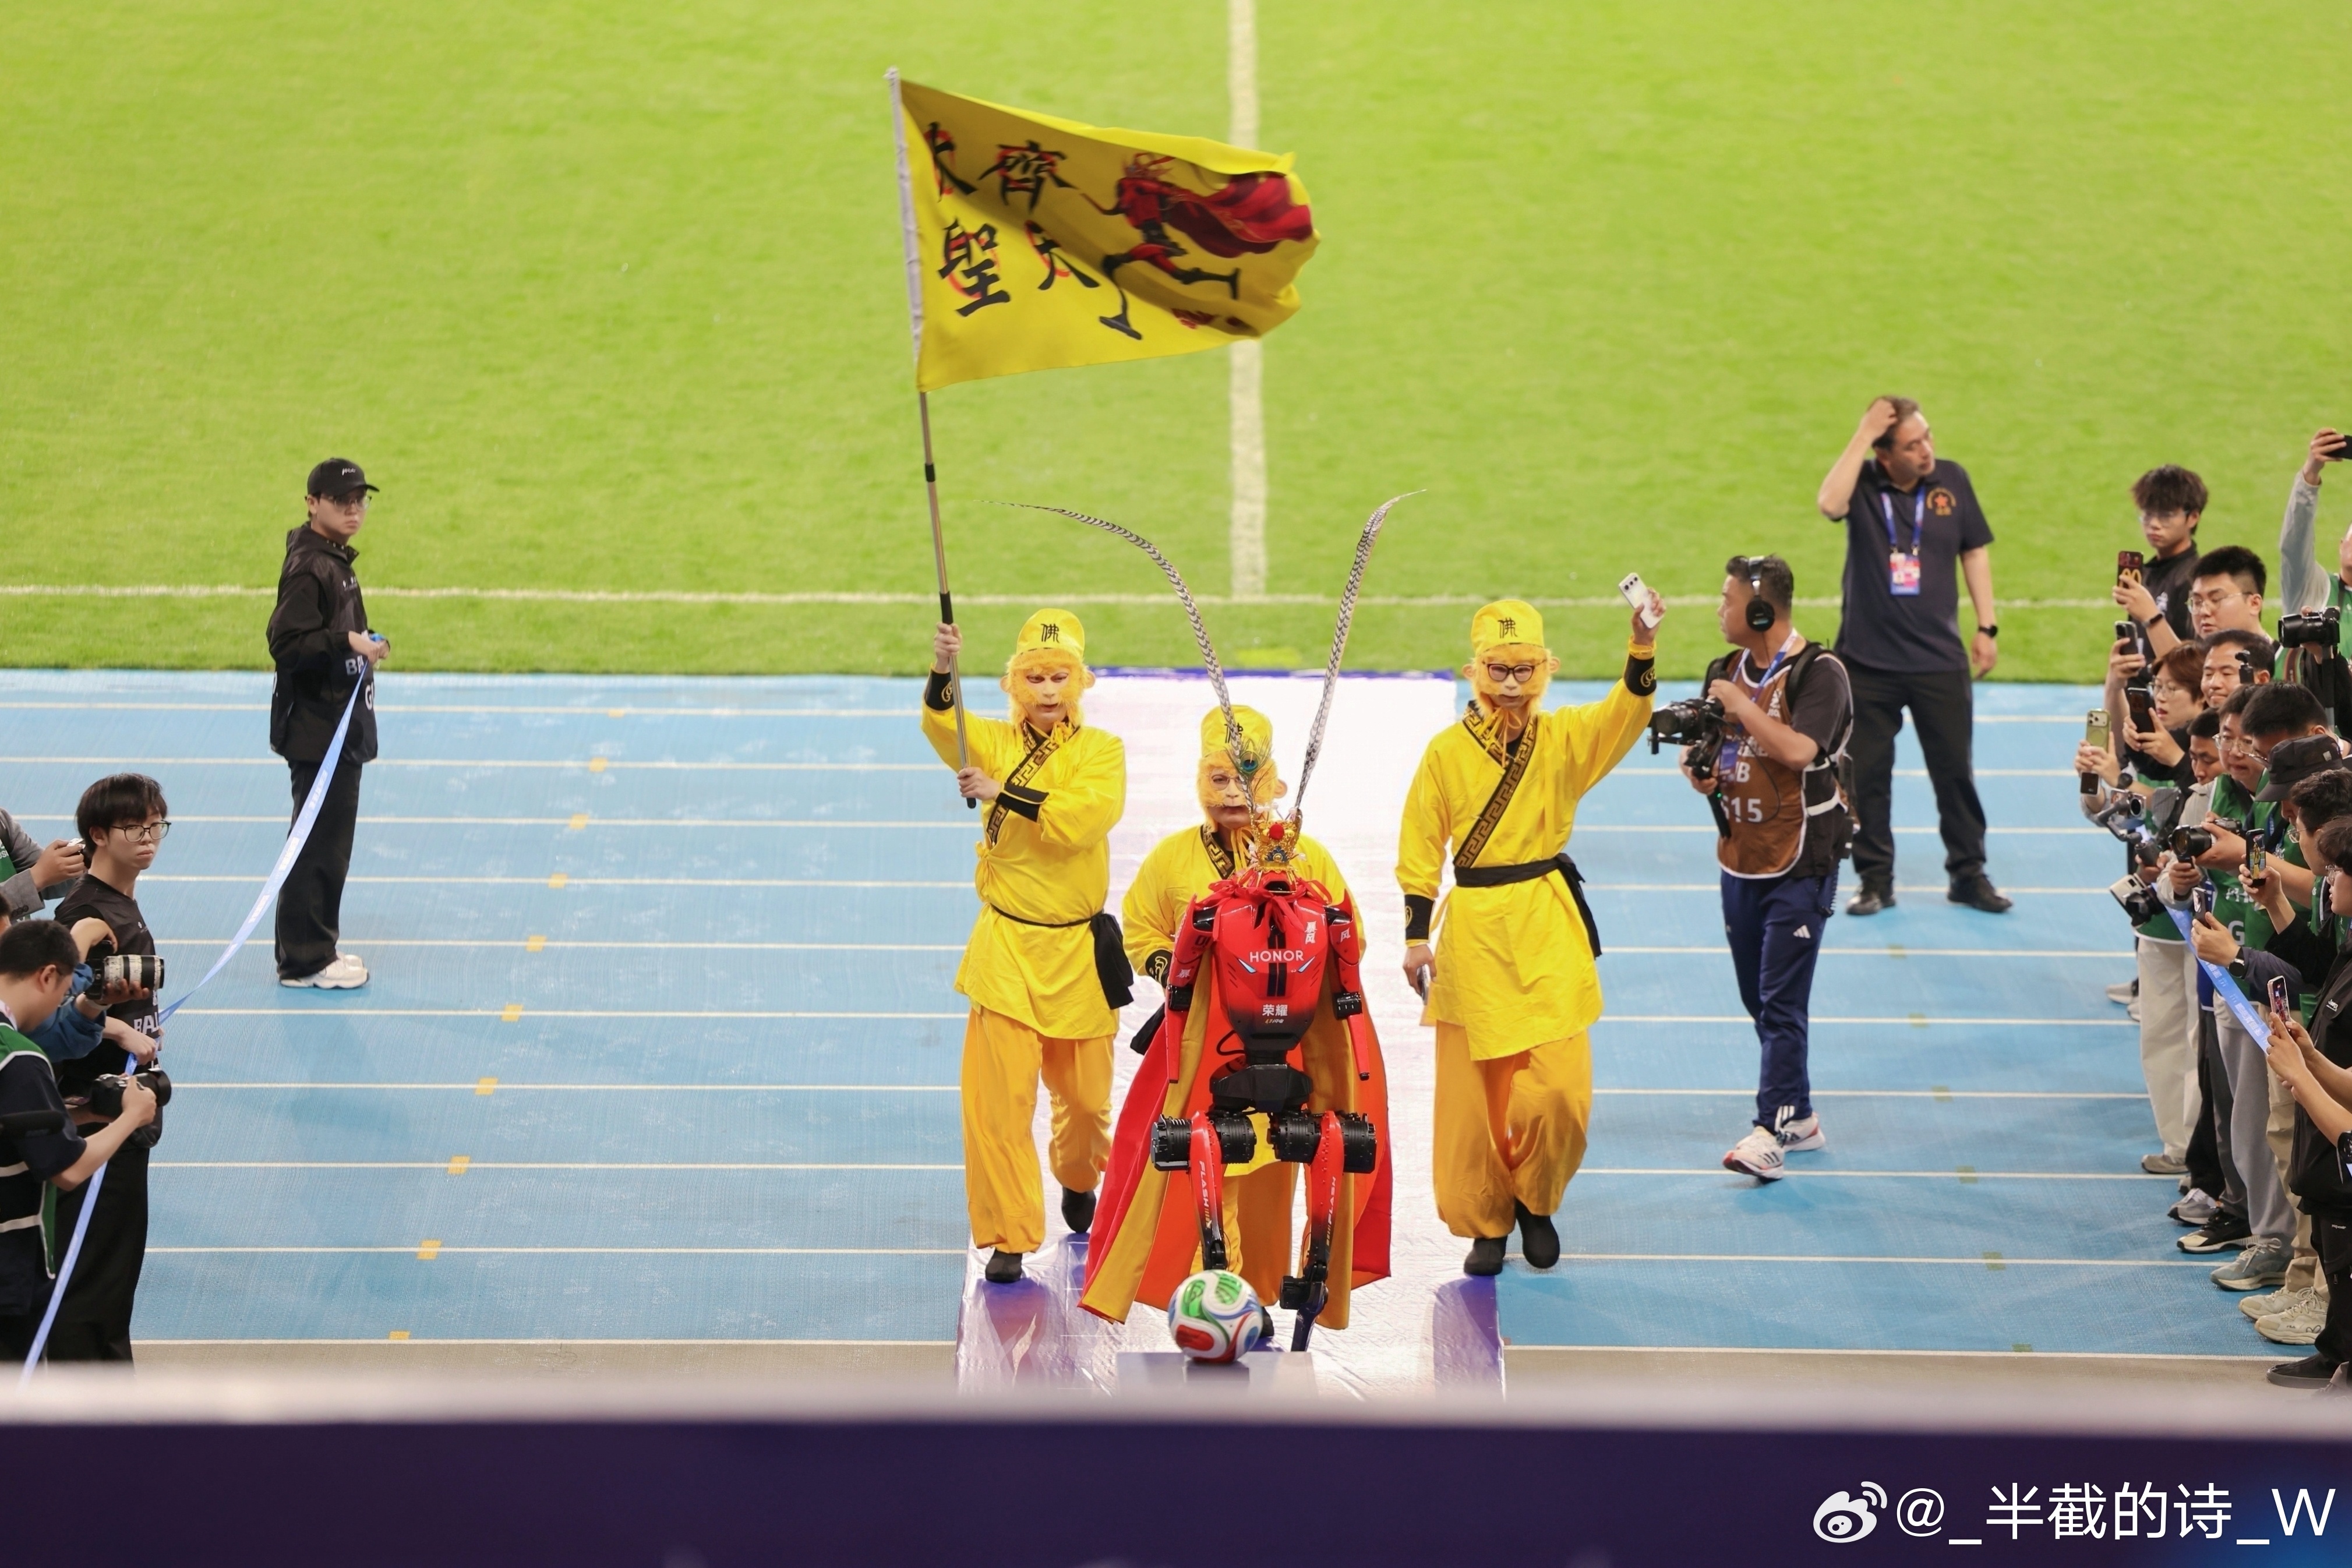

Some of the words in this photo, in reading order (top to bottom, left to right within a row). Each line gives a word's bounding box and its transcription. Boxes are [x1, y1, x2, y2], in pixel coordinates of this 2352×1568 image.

[1041, 623, 1060, 643] 佛
[1498, 617, 1518, 638] 佛
[1249, 950, 1304, 962] HONOR
[1262, 1004, 1288, 1016] 荣耀
[1199, 1160, 1209, 1207] FLASH
[1328, 1176, 1336, 1225] FLASH
